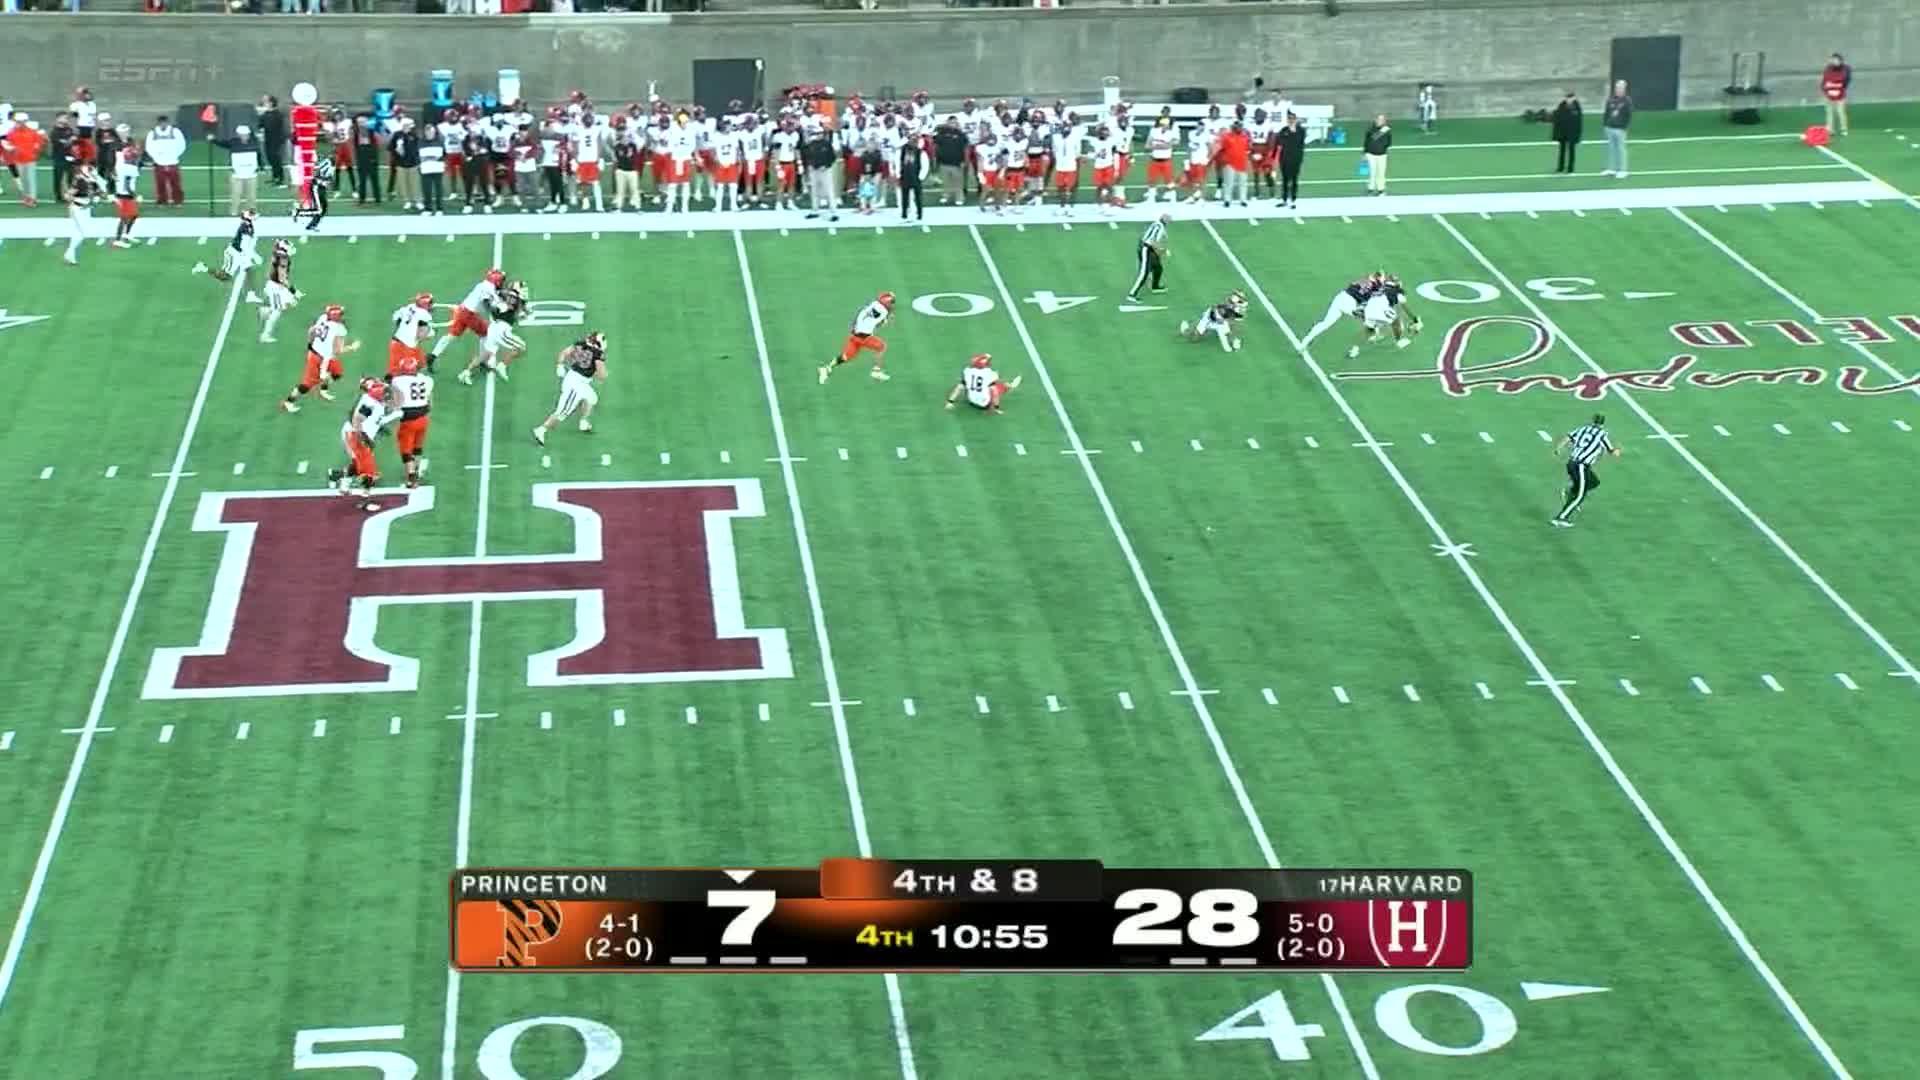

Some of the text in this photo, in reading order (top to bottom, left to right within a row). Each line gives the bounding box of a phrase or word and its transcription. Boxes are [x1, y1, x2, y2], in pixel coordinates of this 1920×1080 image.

[911, 290, 1098, 317] 40
[1415, 278, 1604, 303] 30
[141, 478, 795, 700] H
[1193, 983, 1519, 1062] 40
